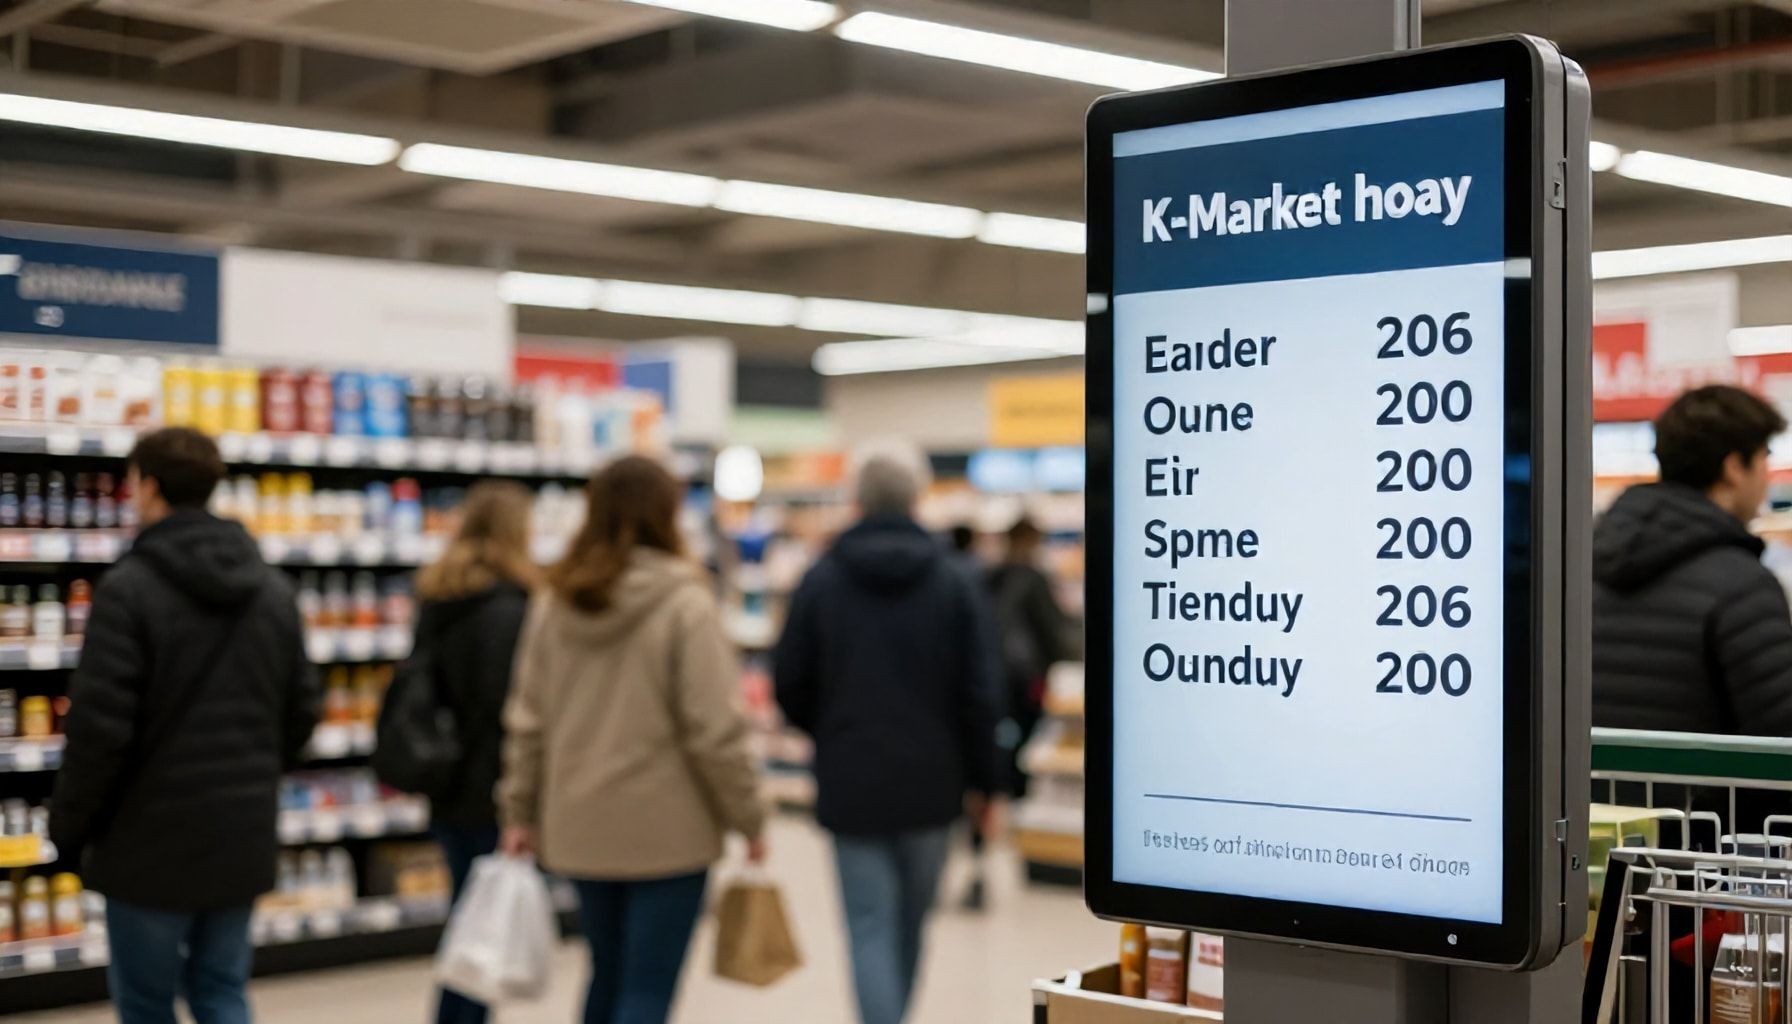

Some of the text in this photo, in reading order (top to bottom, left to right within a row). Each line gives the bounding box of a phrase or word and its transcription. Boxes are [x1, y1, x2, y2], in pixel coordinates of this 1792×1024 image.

[1142, 173, 1473, 243] K-Market hoay
[1376, 311, 1473, 359] 206
[1143, 379, 1473, 435] Oune 200
[1145, 447, 1473, 497] Eir 200
[1144, 516, 1472, 569] Spme 200
[1142, 580, 1472, 634] Tienduy 206
[1142, 642, 1472, 698] Ounduy 200
